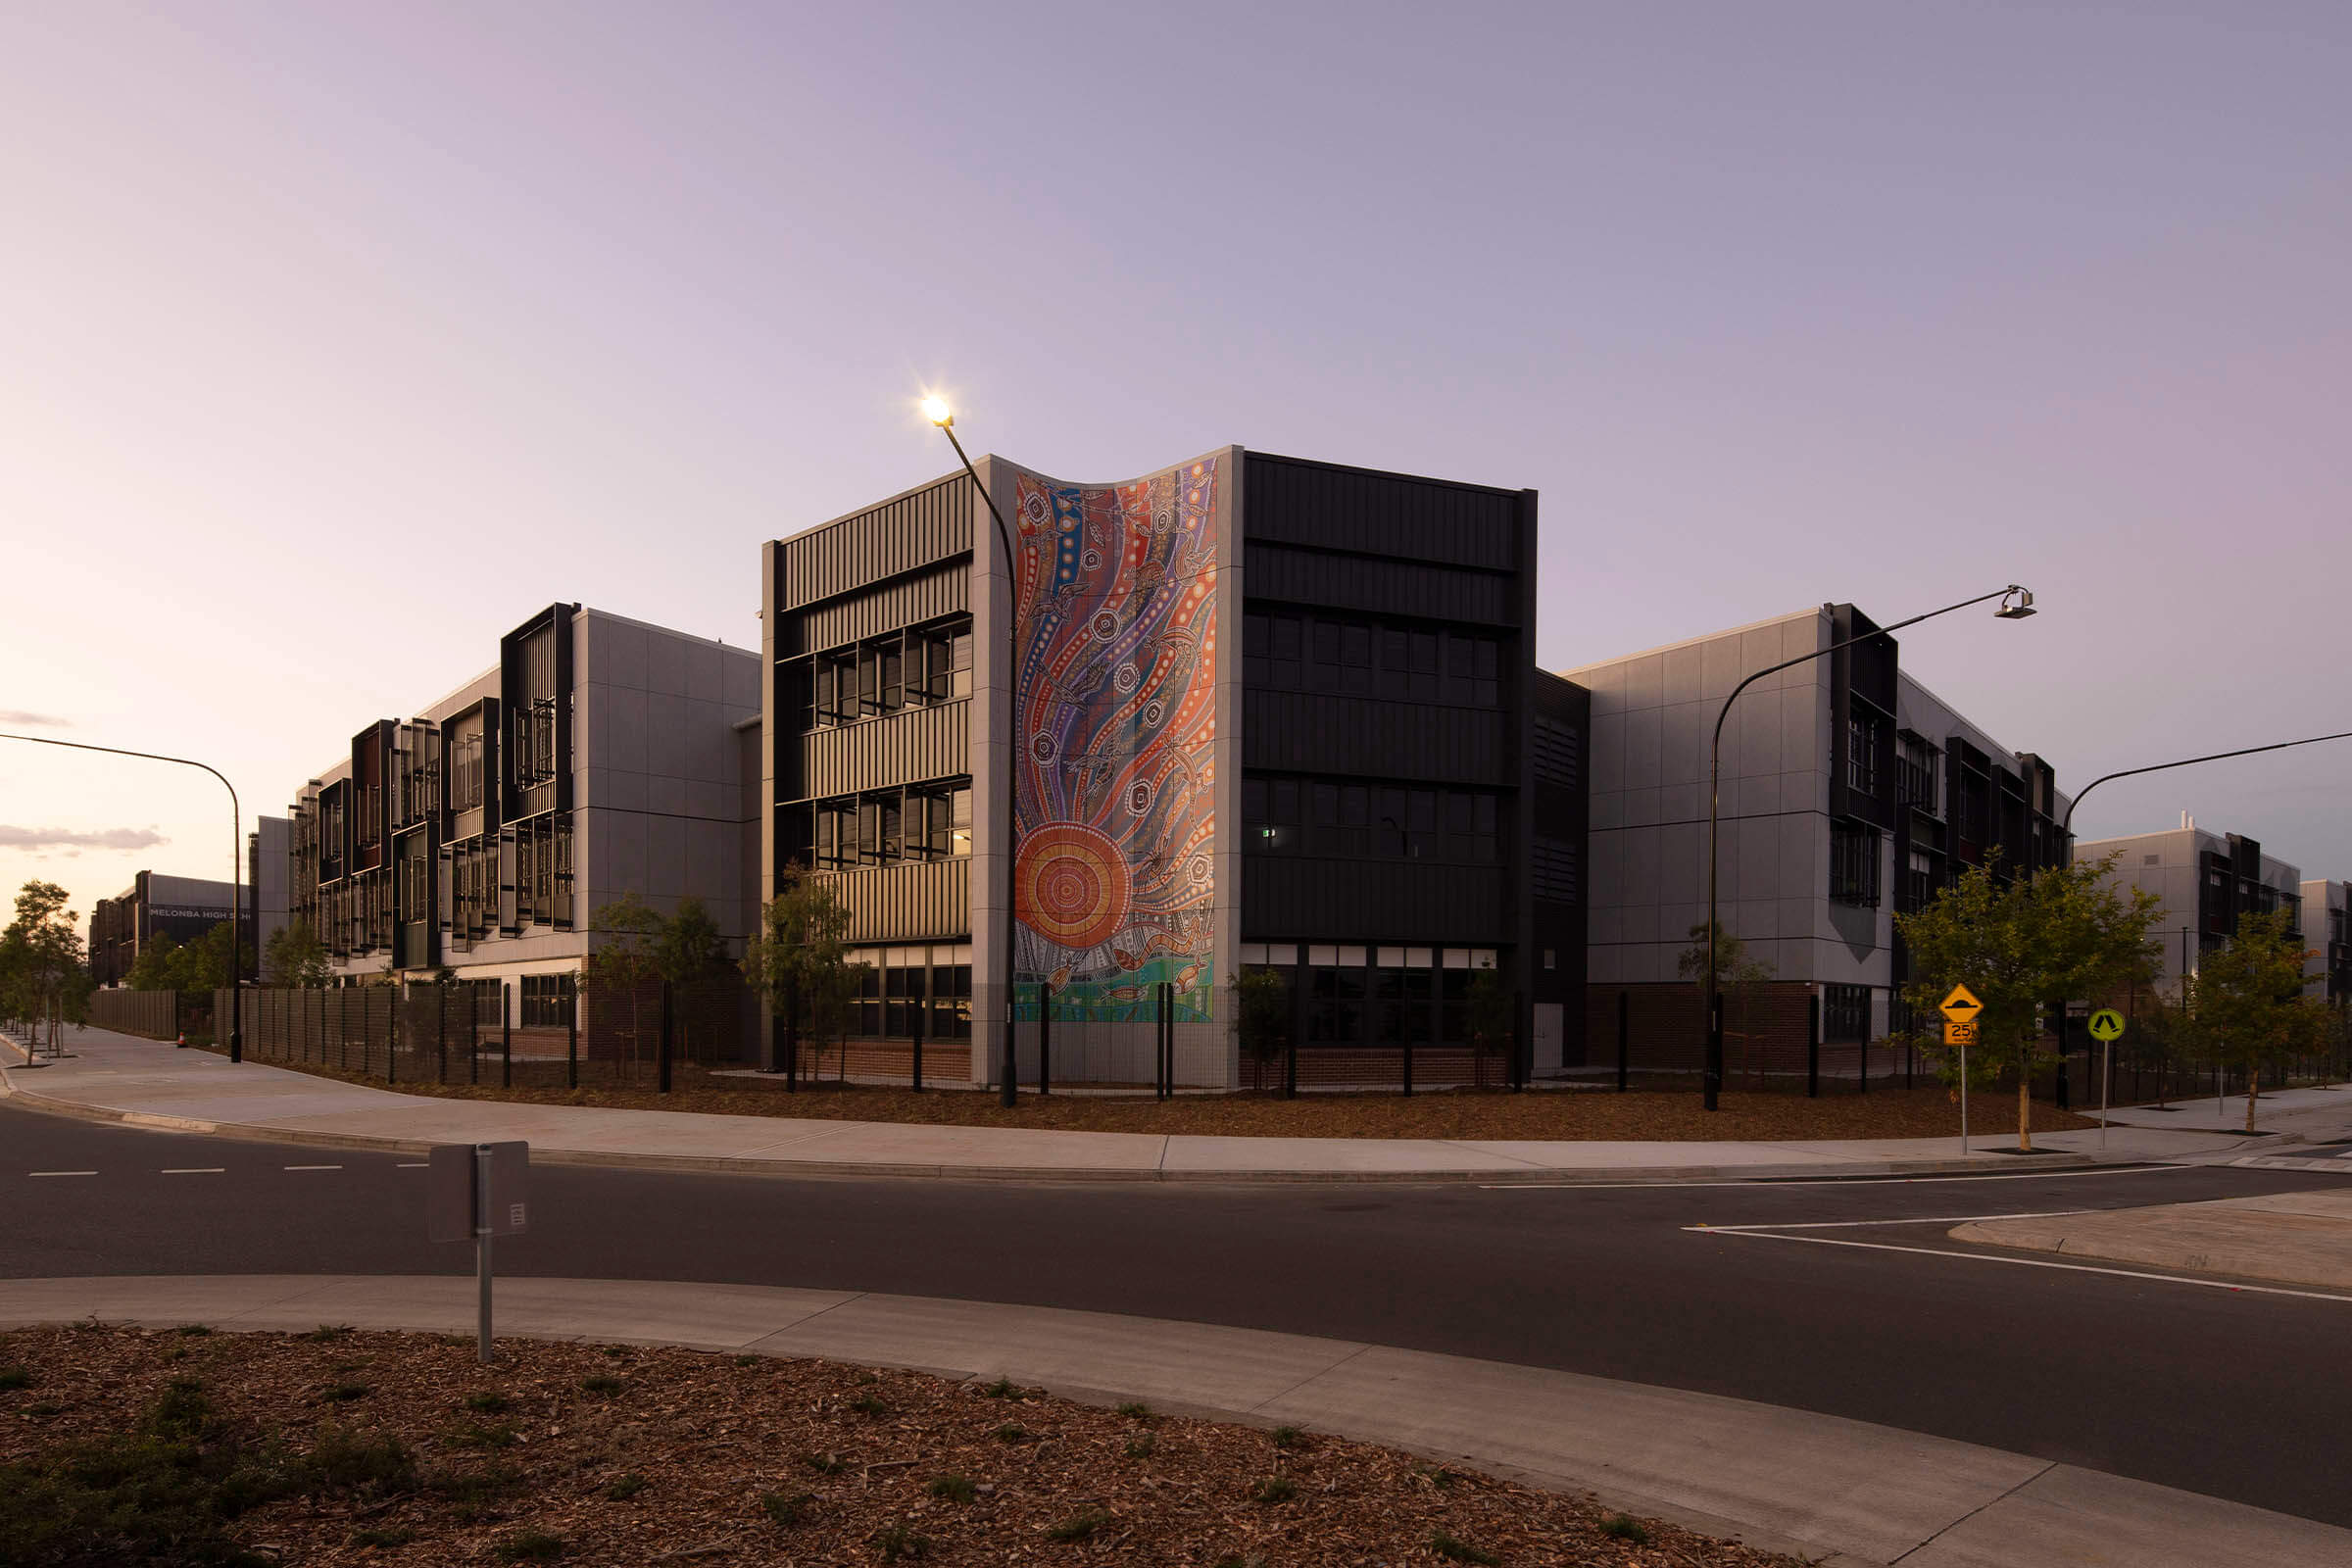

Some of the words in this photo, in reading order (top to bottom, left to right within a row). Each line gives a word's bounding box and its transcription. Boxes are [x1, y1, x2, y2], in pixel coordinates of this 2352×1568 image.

[150, 908, 200, 918] MELONBA
[203, 910, 226, 919] HIGH
[1952, 1025, 1970, 1036] 25
